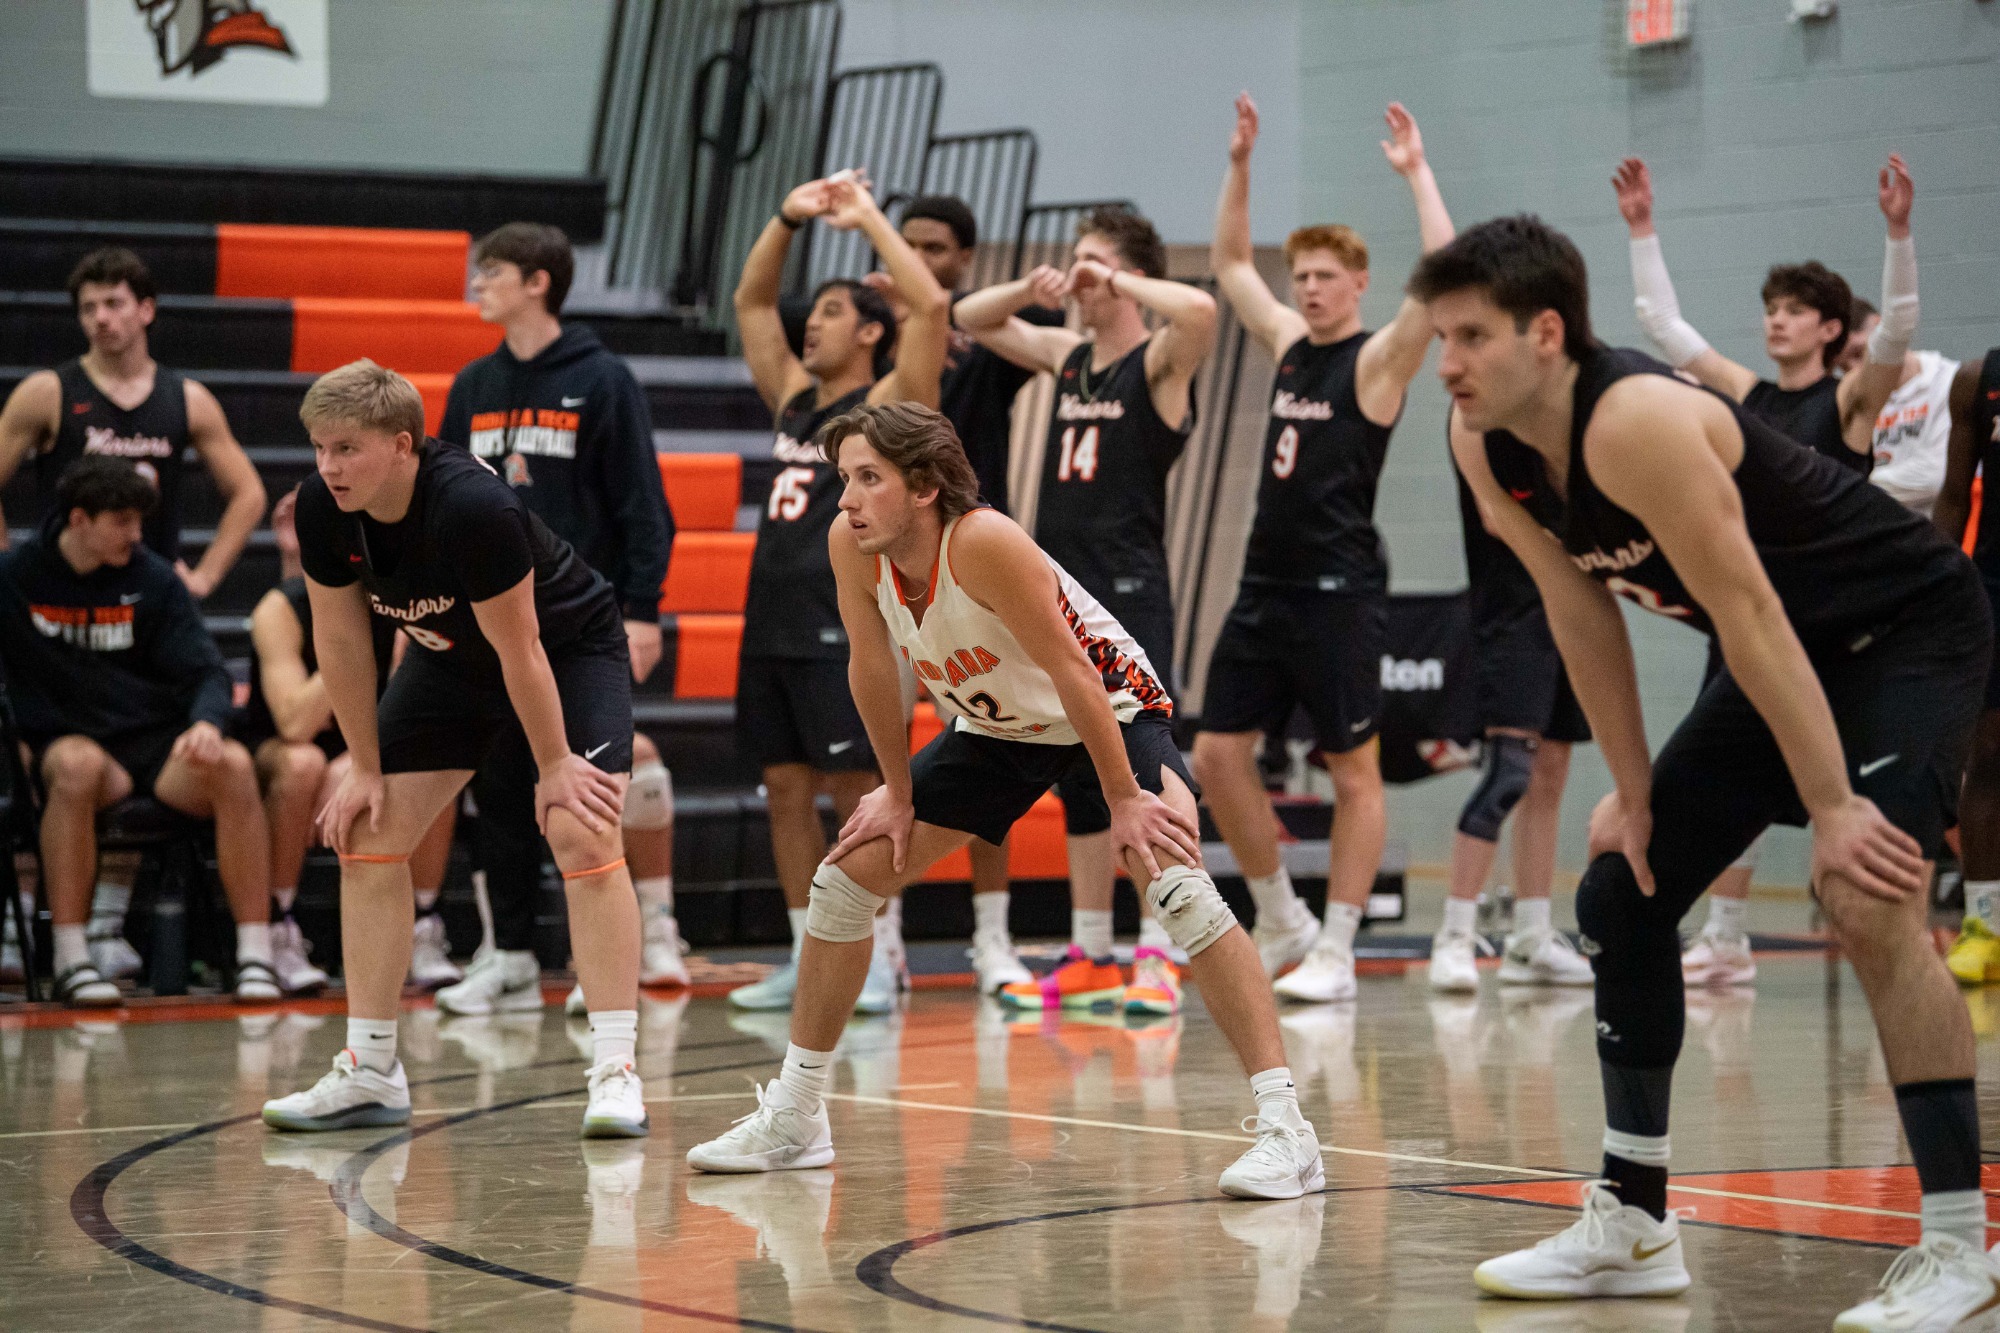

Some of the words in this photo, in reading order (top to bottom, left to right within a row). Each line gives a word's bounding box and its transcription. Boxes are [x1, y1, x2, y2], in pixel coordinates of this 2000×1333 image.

[1057, 425, 1099, 482] 14
[1271, 424, 1299, 479] 9
[767, 465, 815, 521] 15
